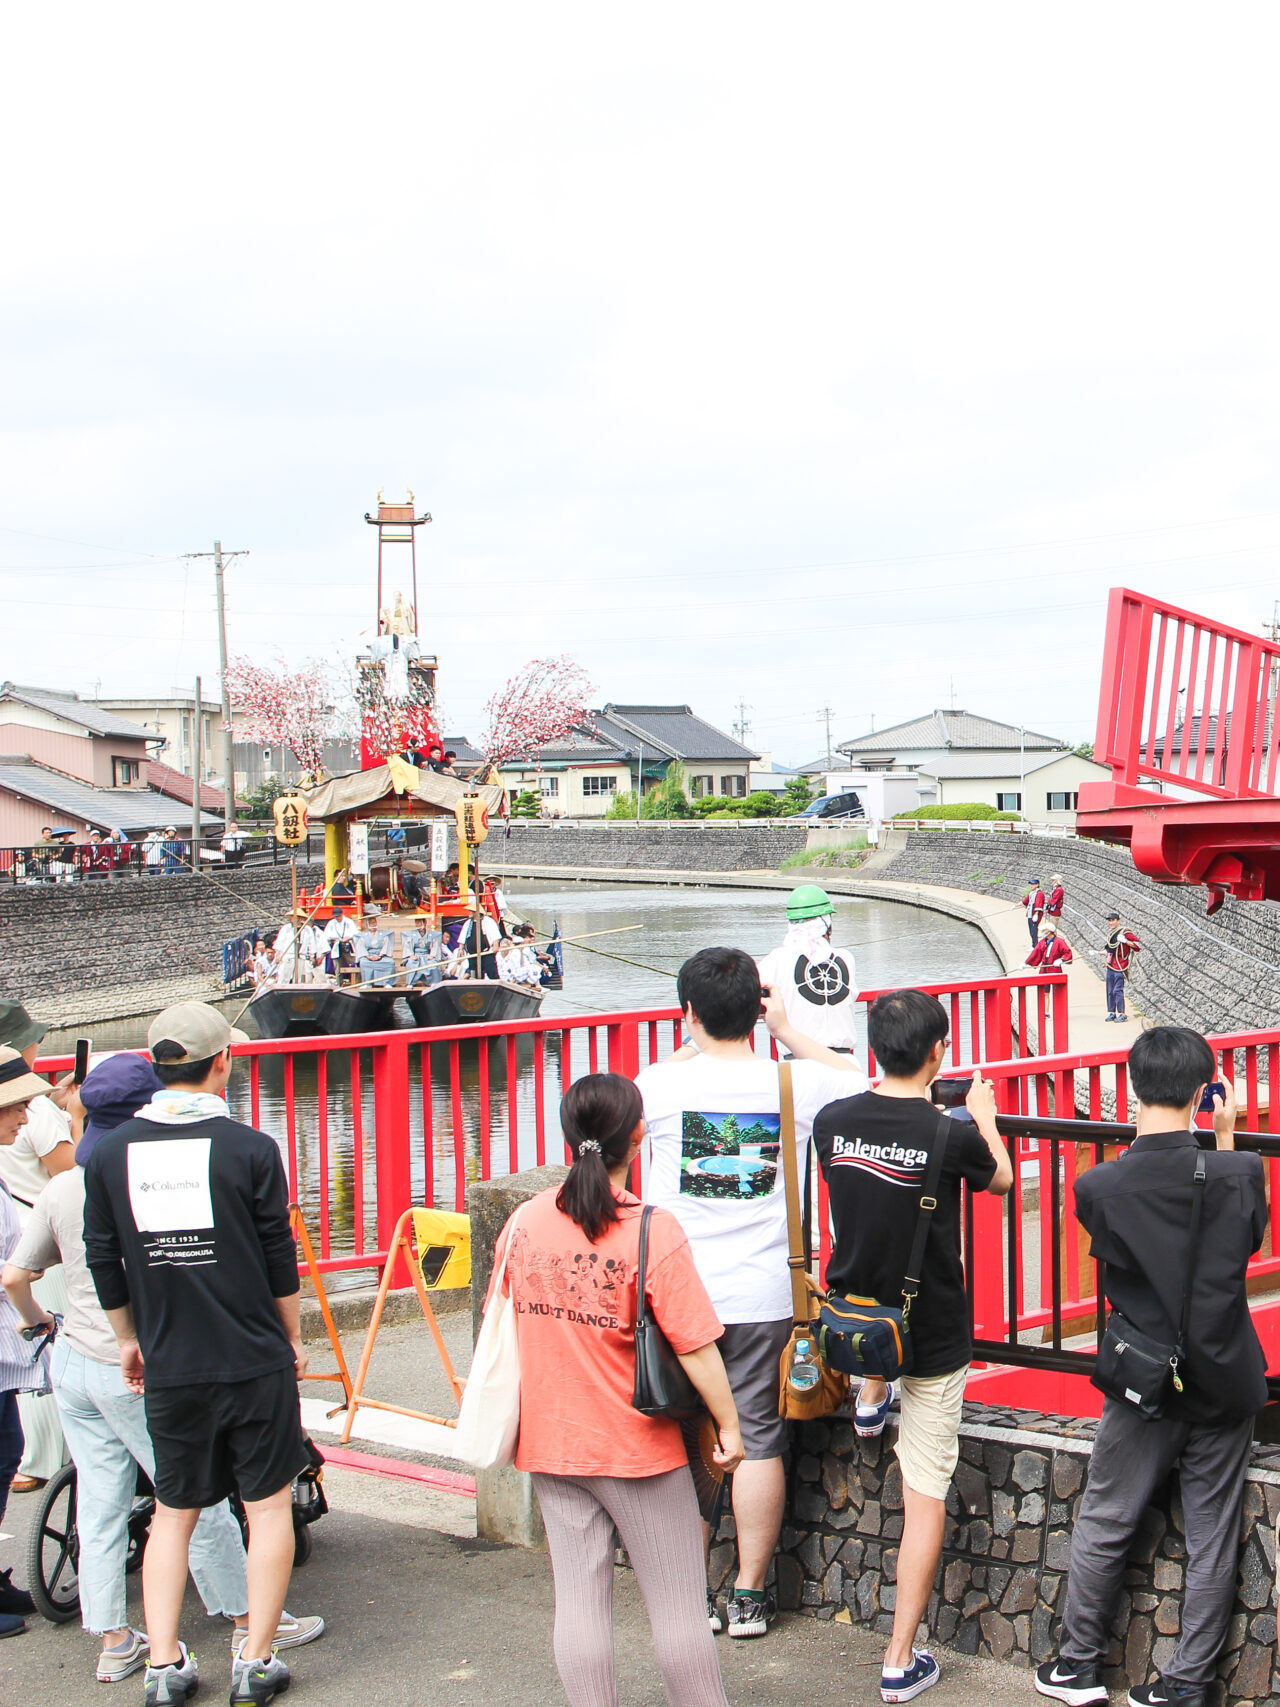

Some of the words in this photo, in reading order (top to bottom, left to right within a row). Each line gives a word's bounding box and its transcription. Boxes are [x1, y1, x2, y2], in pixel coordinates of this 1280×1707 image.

[832, 1135, 928, 1167] Balenciaga
[151, 1179, 200, 1192] Columbia
[567, 1309, 619, 1329] DANCE
